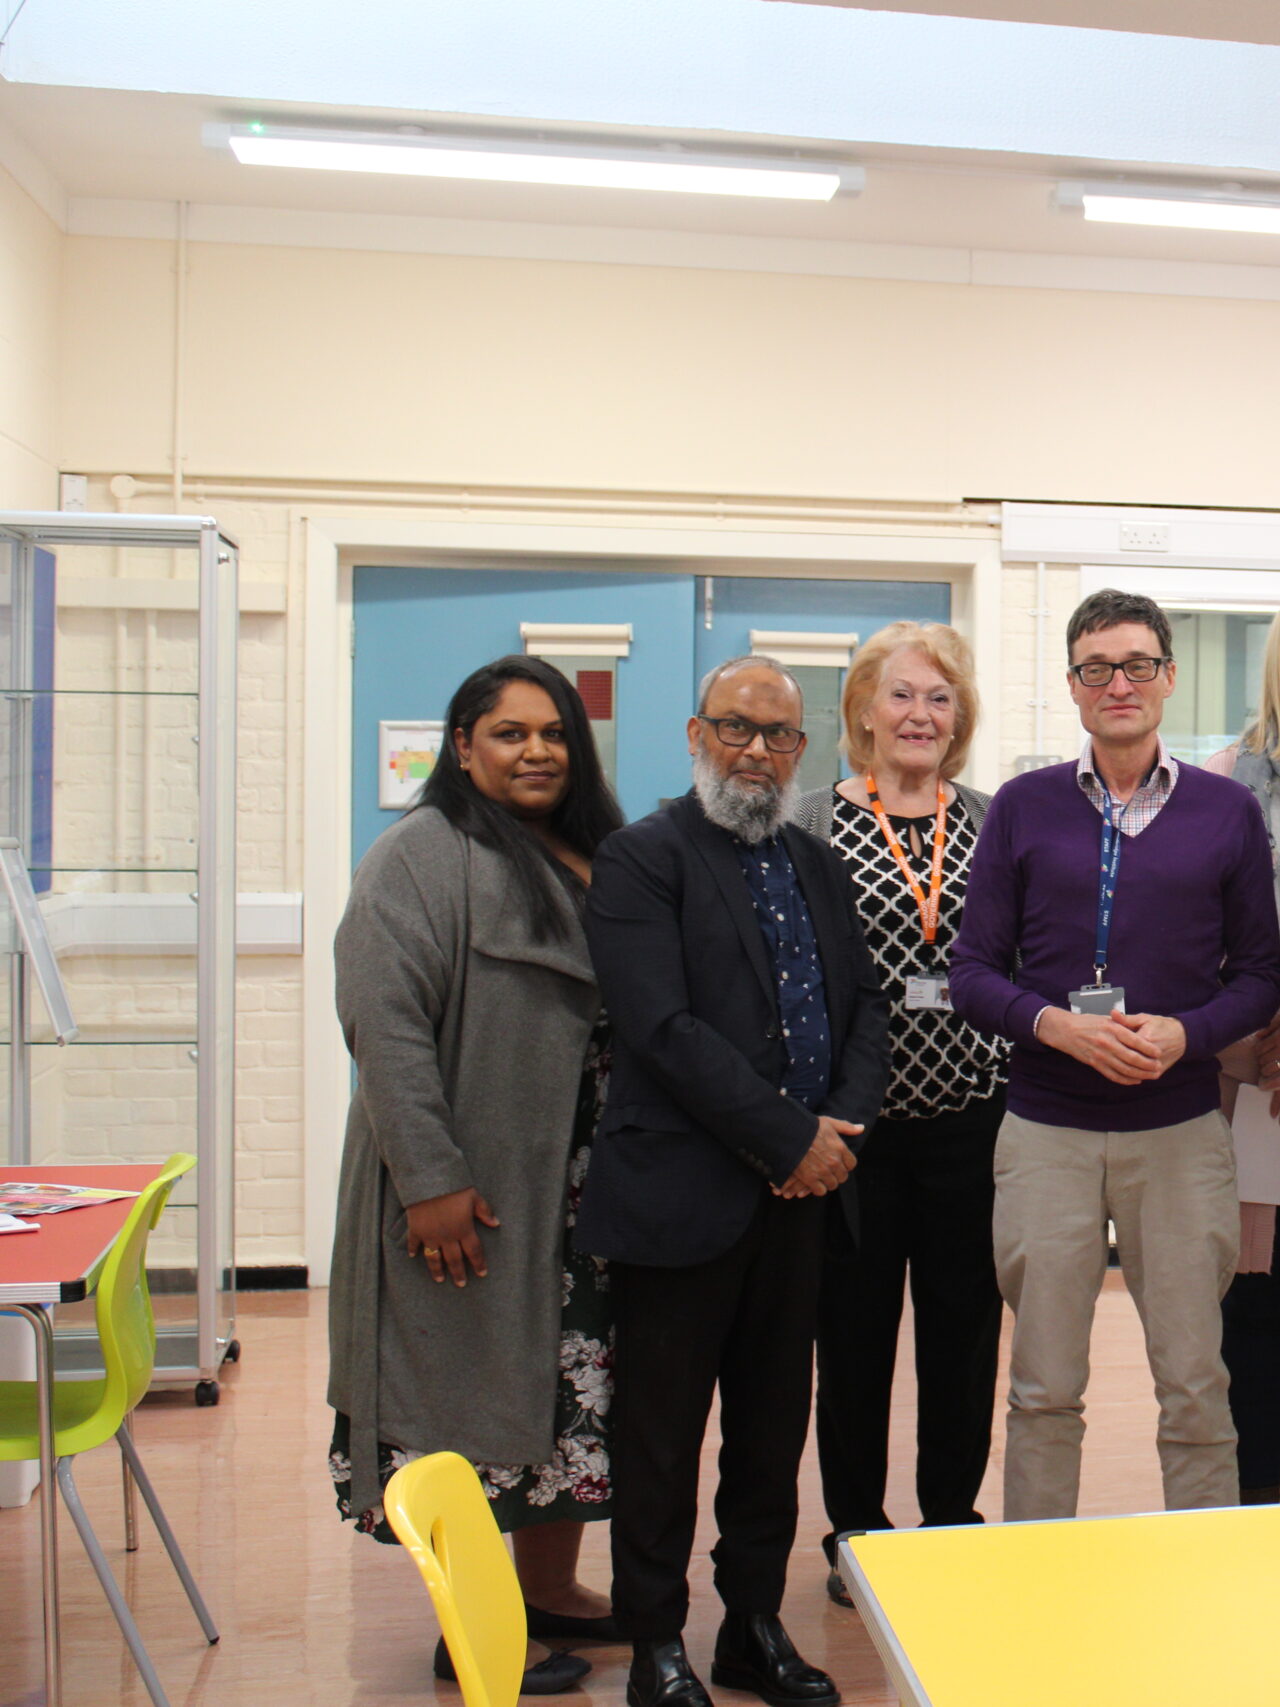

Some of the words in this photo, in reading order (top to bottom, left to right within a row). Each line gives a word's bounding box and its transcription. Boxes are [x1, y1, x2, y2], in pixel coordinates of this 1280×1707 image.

[878, 812, 897, 845] GOVERNOR
[937, 802, 947, 834] GOVERNOR
[898, 856, 919, 887] GOVERNOR
[933, 844, 943, 877] GOVERNOR
[928, 888, 939, 929] GOVERNOR
